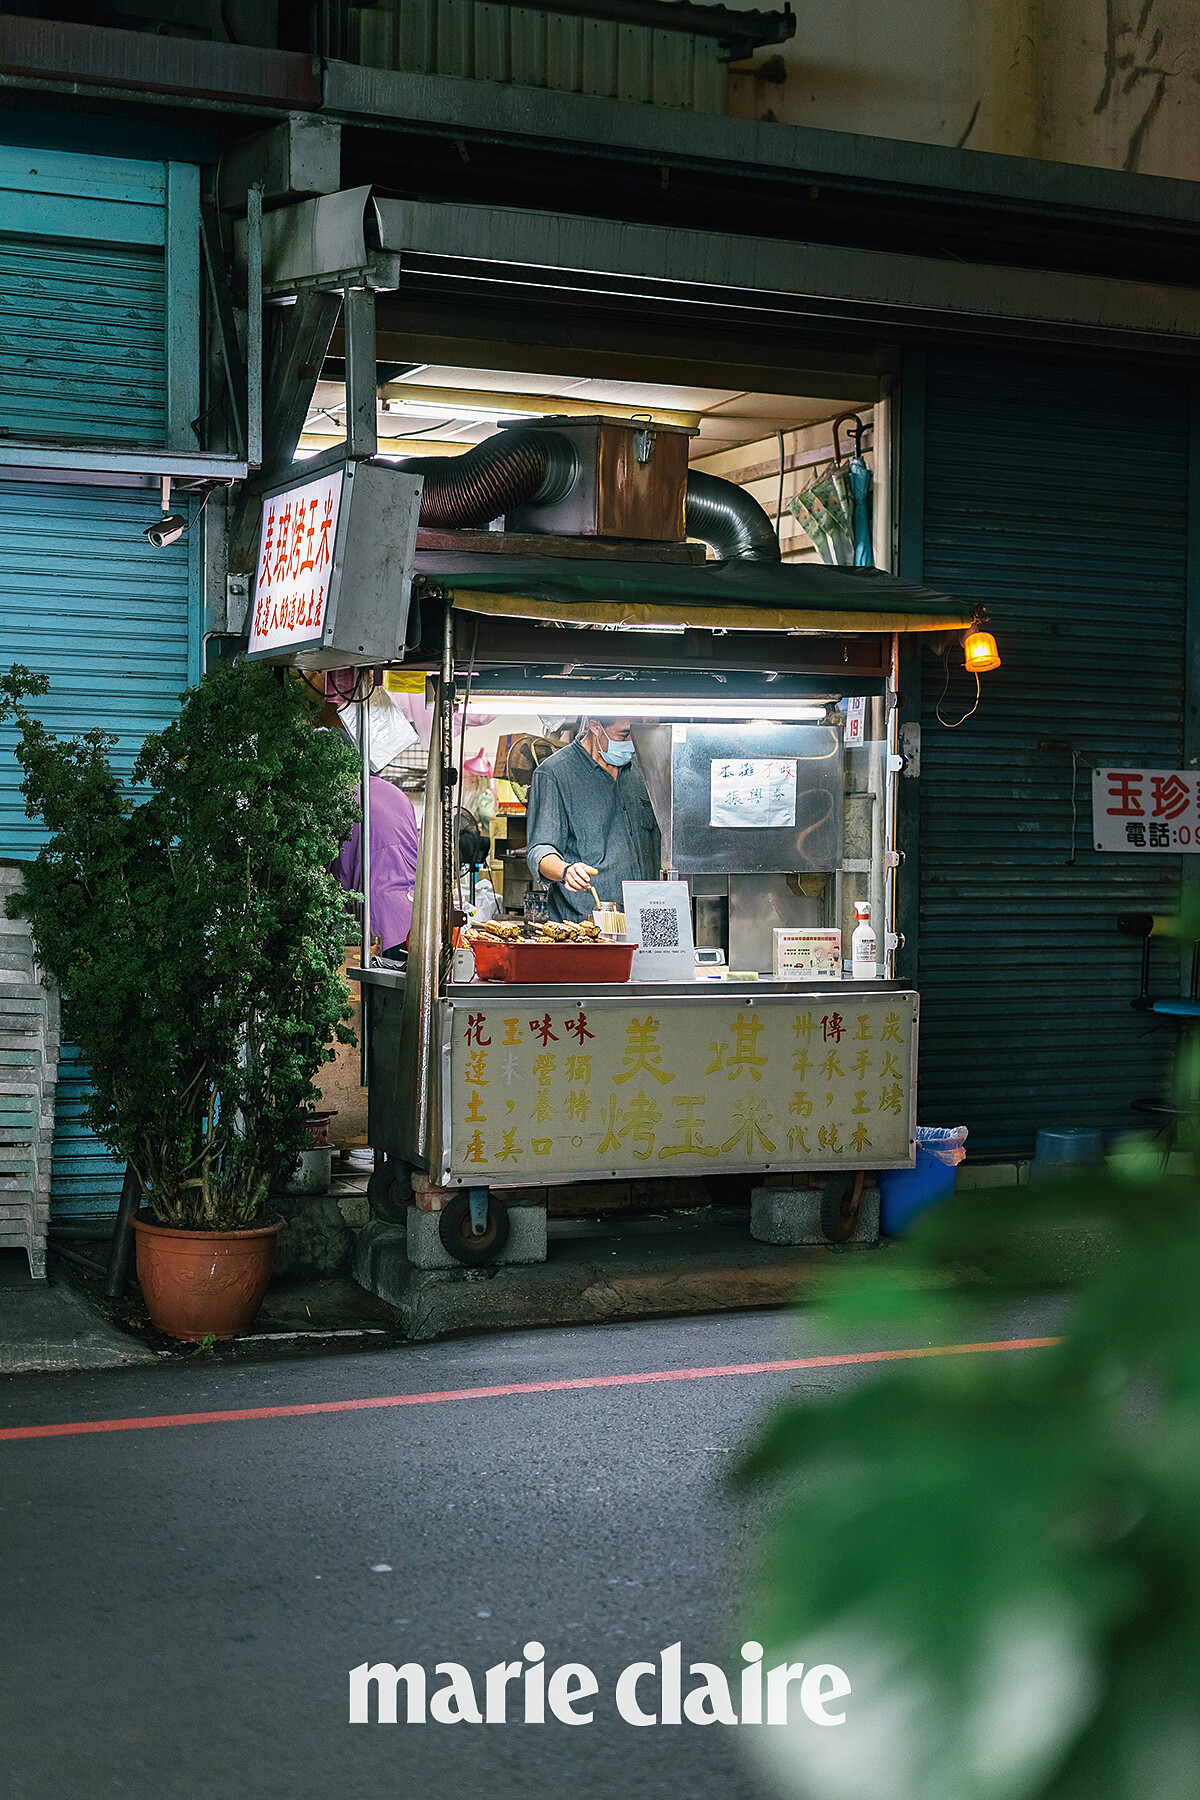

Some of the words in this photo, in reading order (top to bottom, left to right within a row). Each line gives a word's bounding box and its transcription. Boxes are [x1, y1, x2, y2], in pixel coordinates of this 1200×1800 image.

[259, 489, 333, 588] 美琪烤玉米
[254, 585, 325, 637] 花蓮人的道地土產
[850, 719, 859, 737] 19
[1106, 773, 1200, 820] 玉珍
[463, 1012, 493, 1164] 花蓮土產
[877, 1011, 906, 1116] 炭火烤
[597, 1090, 777, 1160] 烤玉米
